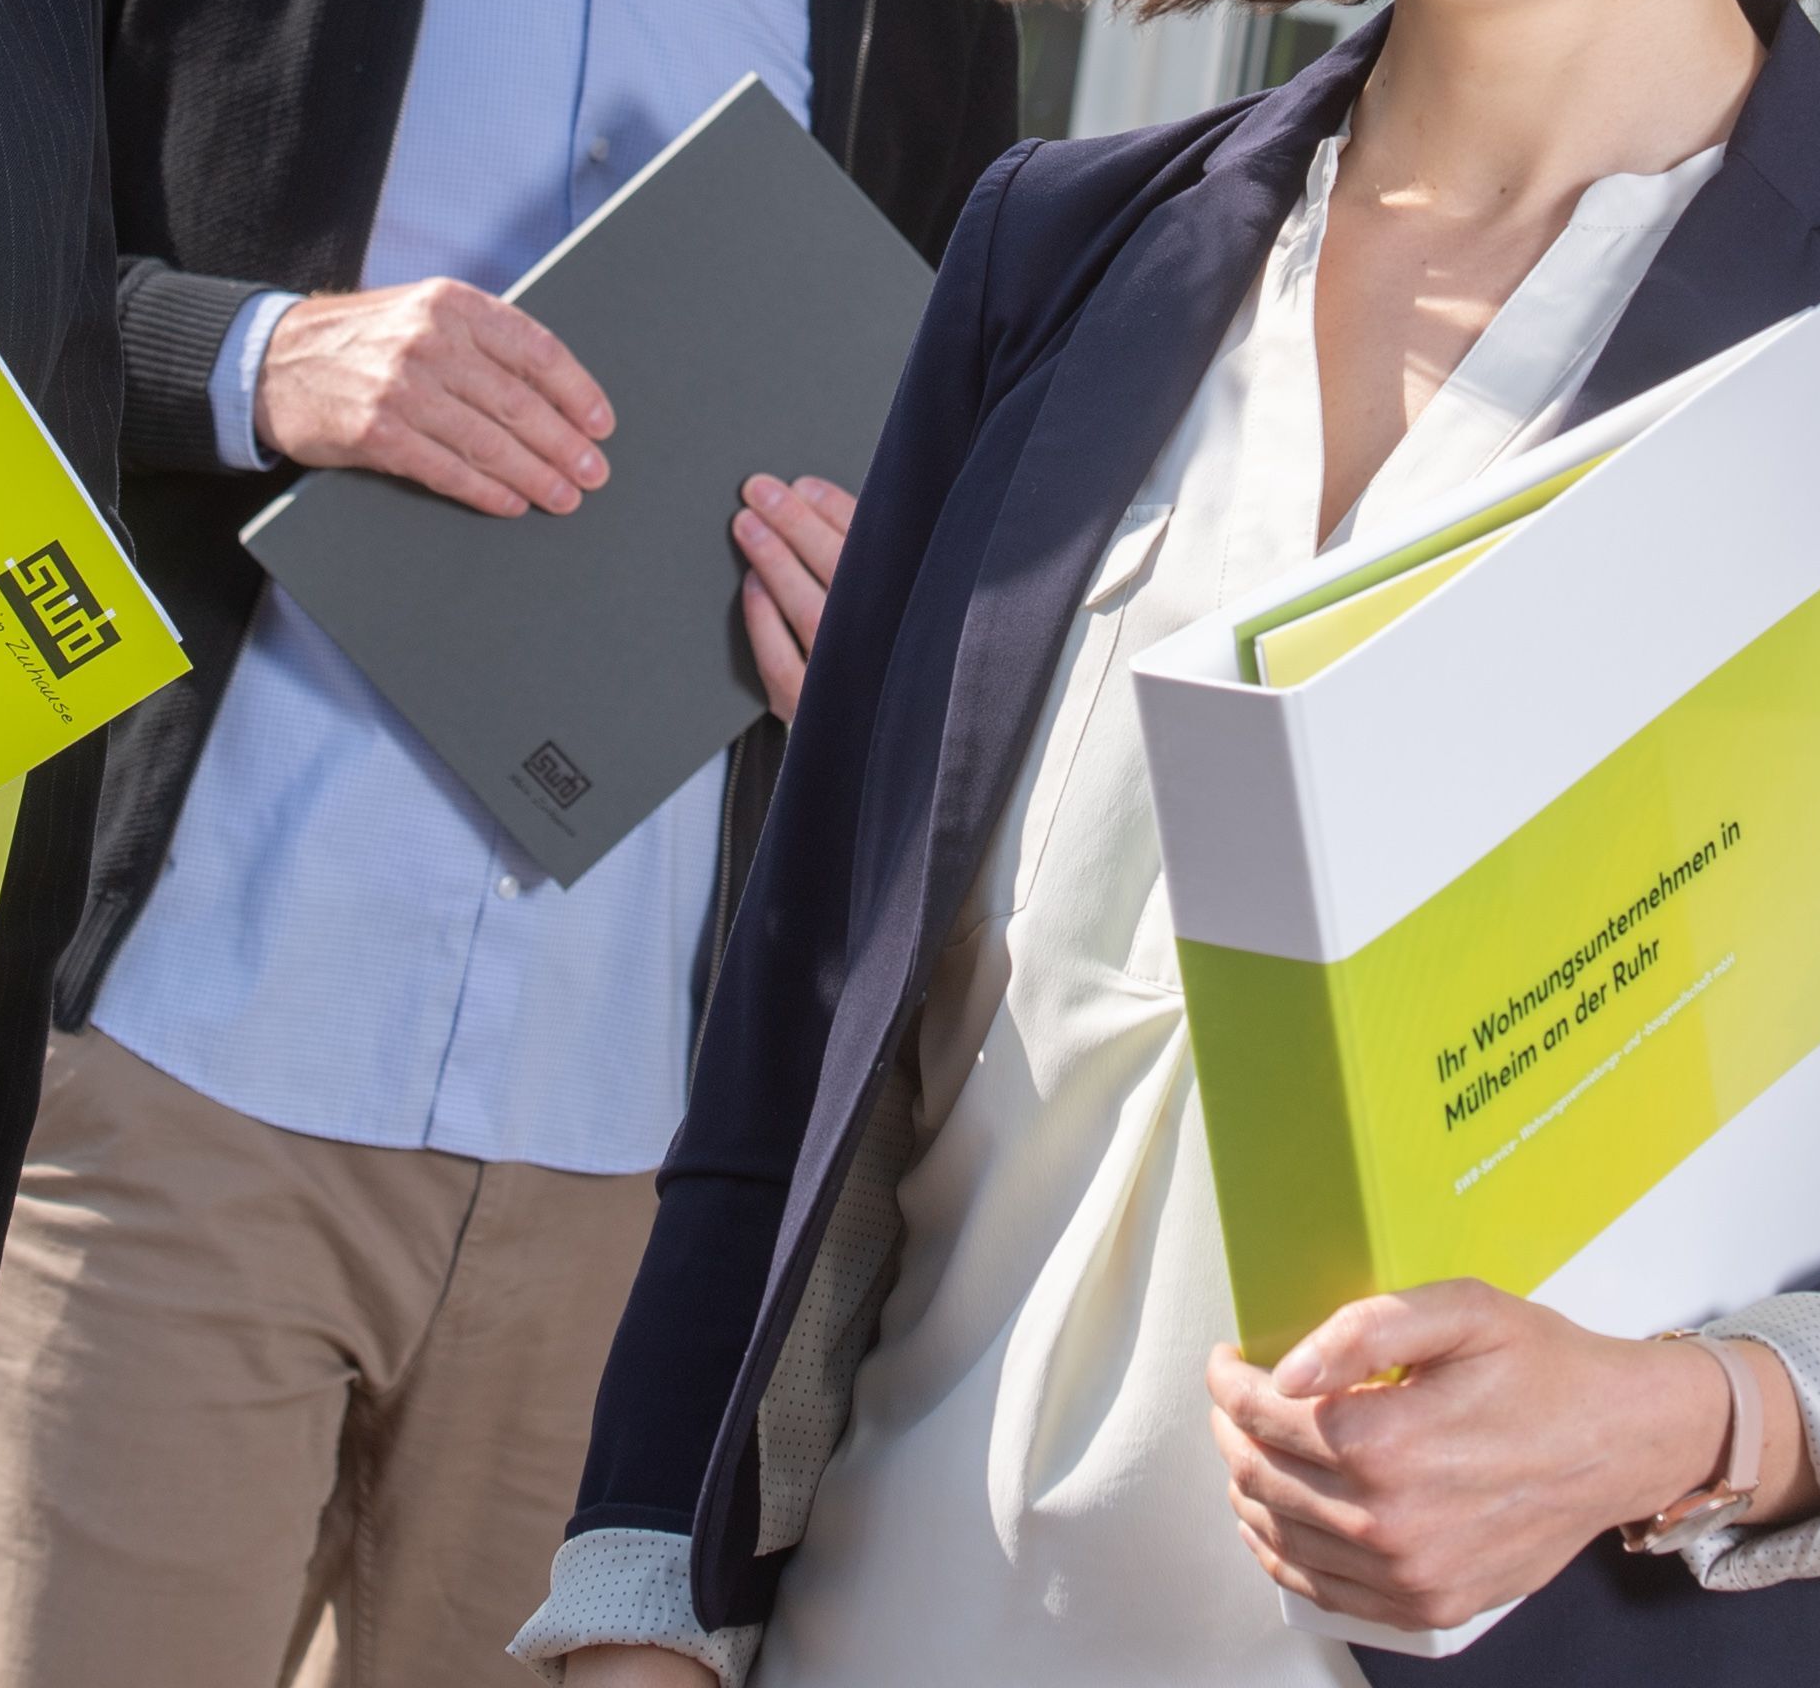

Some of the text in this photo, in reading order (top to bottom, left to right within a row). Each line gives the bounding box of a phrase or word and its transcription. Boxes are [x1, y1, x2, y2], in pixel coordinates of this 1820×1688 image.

[5, 638, 73, 725] Zuhause
[1437, 820, 1740, 1083] Ihr Wohnungsunternehmen in
[1444, 938, 1660, 1132] Mülheim an der Ruhr
[1624, 1030, 1641, 1054] und
